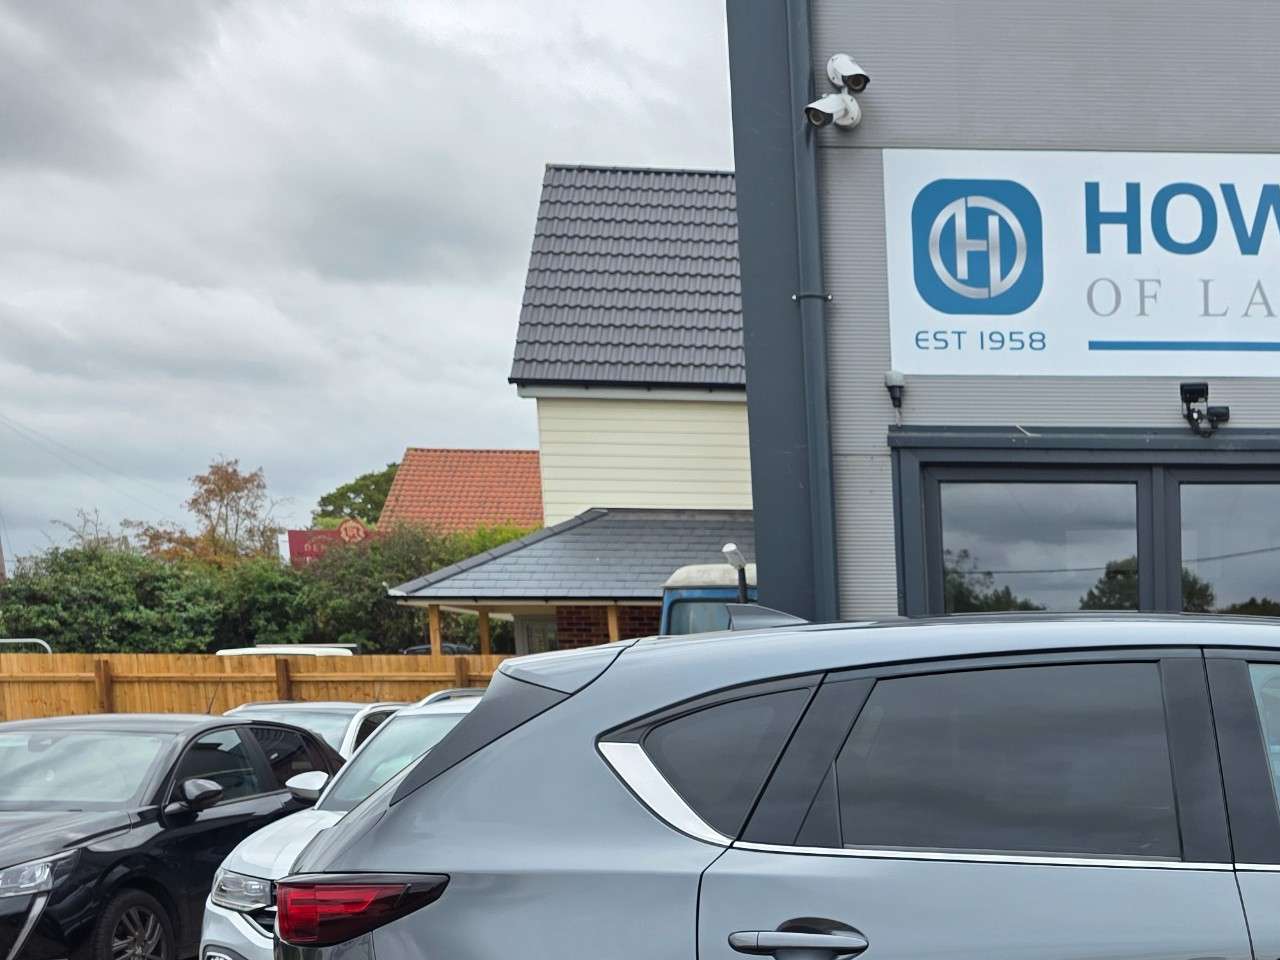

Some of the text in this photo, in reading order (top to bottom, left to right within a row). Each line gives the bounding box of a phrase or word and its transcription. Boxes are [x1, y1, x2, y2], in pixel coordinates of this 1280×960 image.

[1086, 277, 1162, 318] OF
[914, 330, 1047, 352] EST 1958
